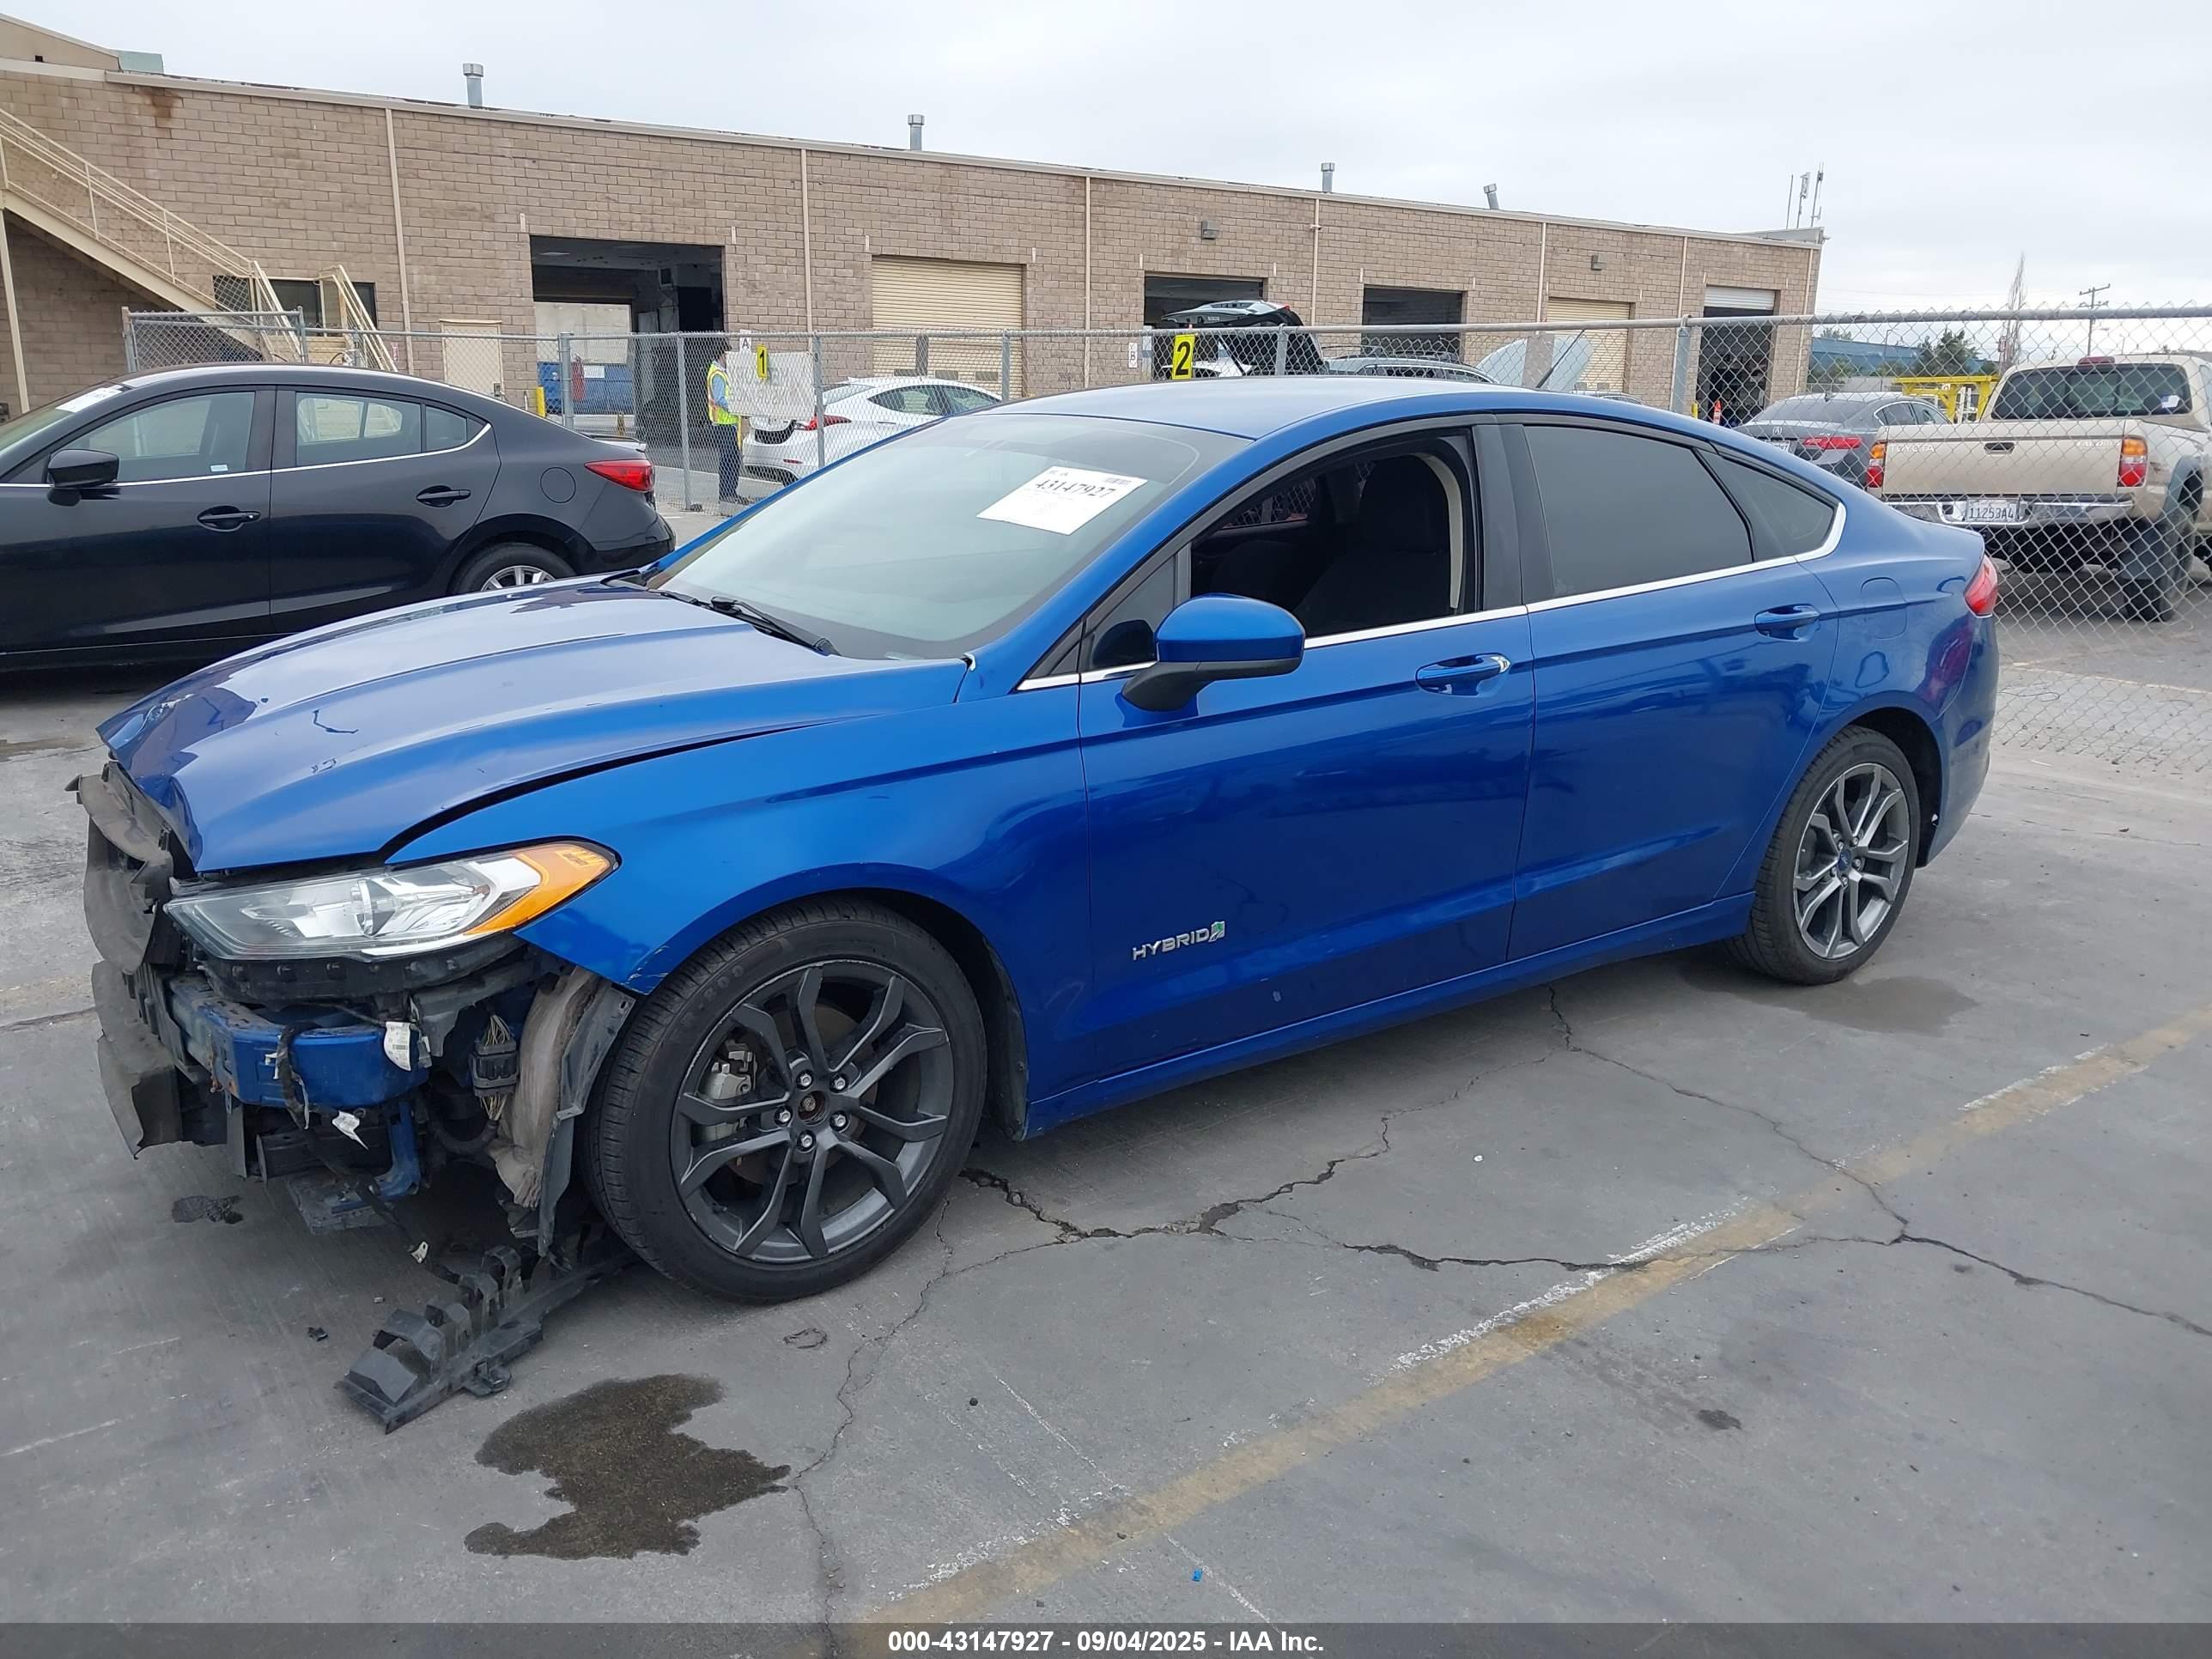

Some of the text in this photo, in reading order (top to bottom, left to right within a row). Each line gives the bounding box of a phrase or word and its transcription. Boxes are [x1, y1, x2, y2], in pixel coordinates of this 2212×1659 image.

[742, 338, 749, 349] A
[759, 349, 765, 374] 1
[1175, 341, 1191, 375] 2
[1888, 443, 1934, 453] TOYOTA
[1036, 479, 1116, 498] 43147927
[1133, 928, 1209, 960] HYBRID
